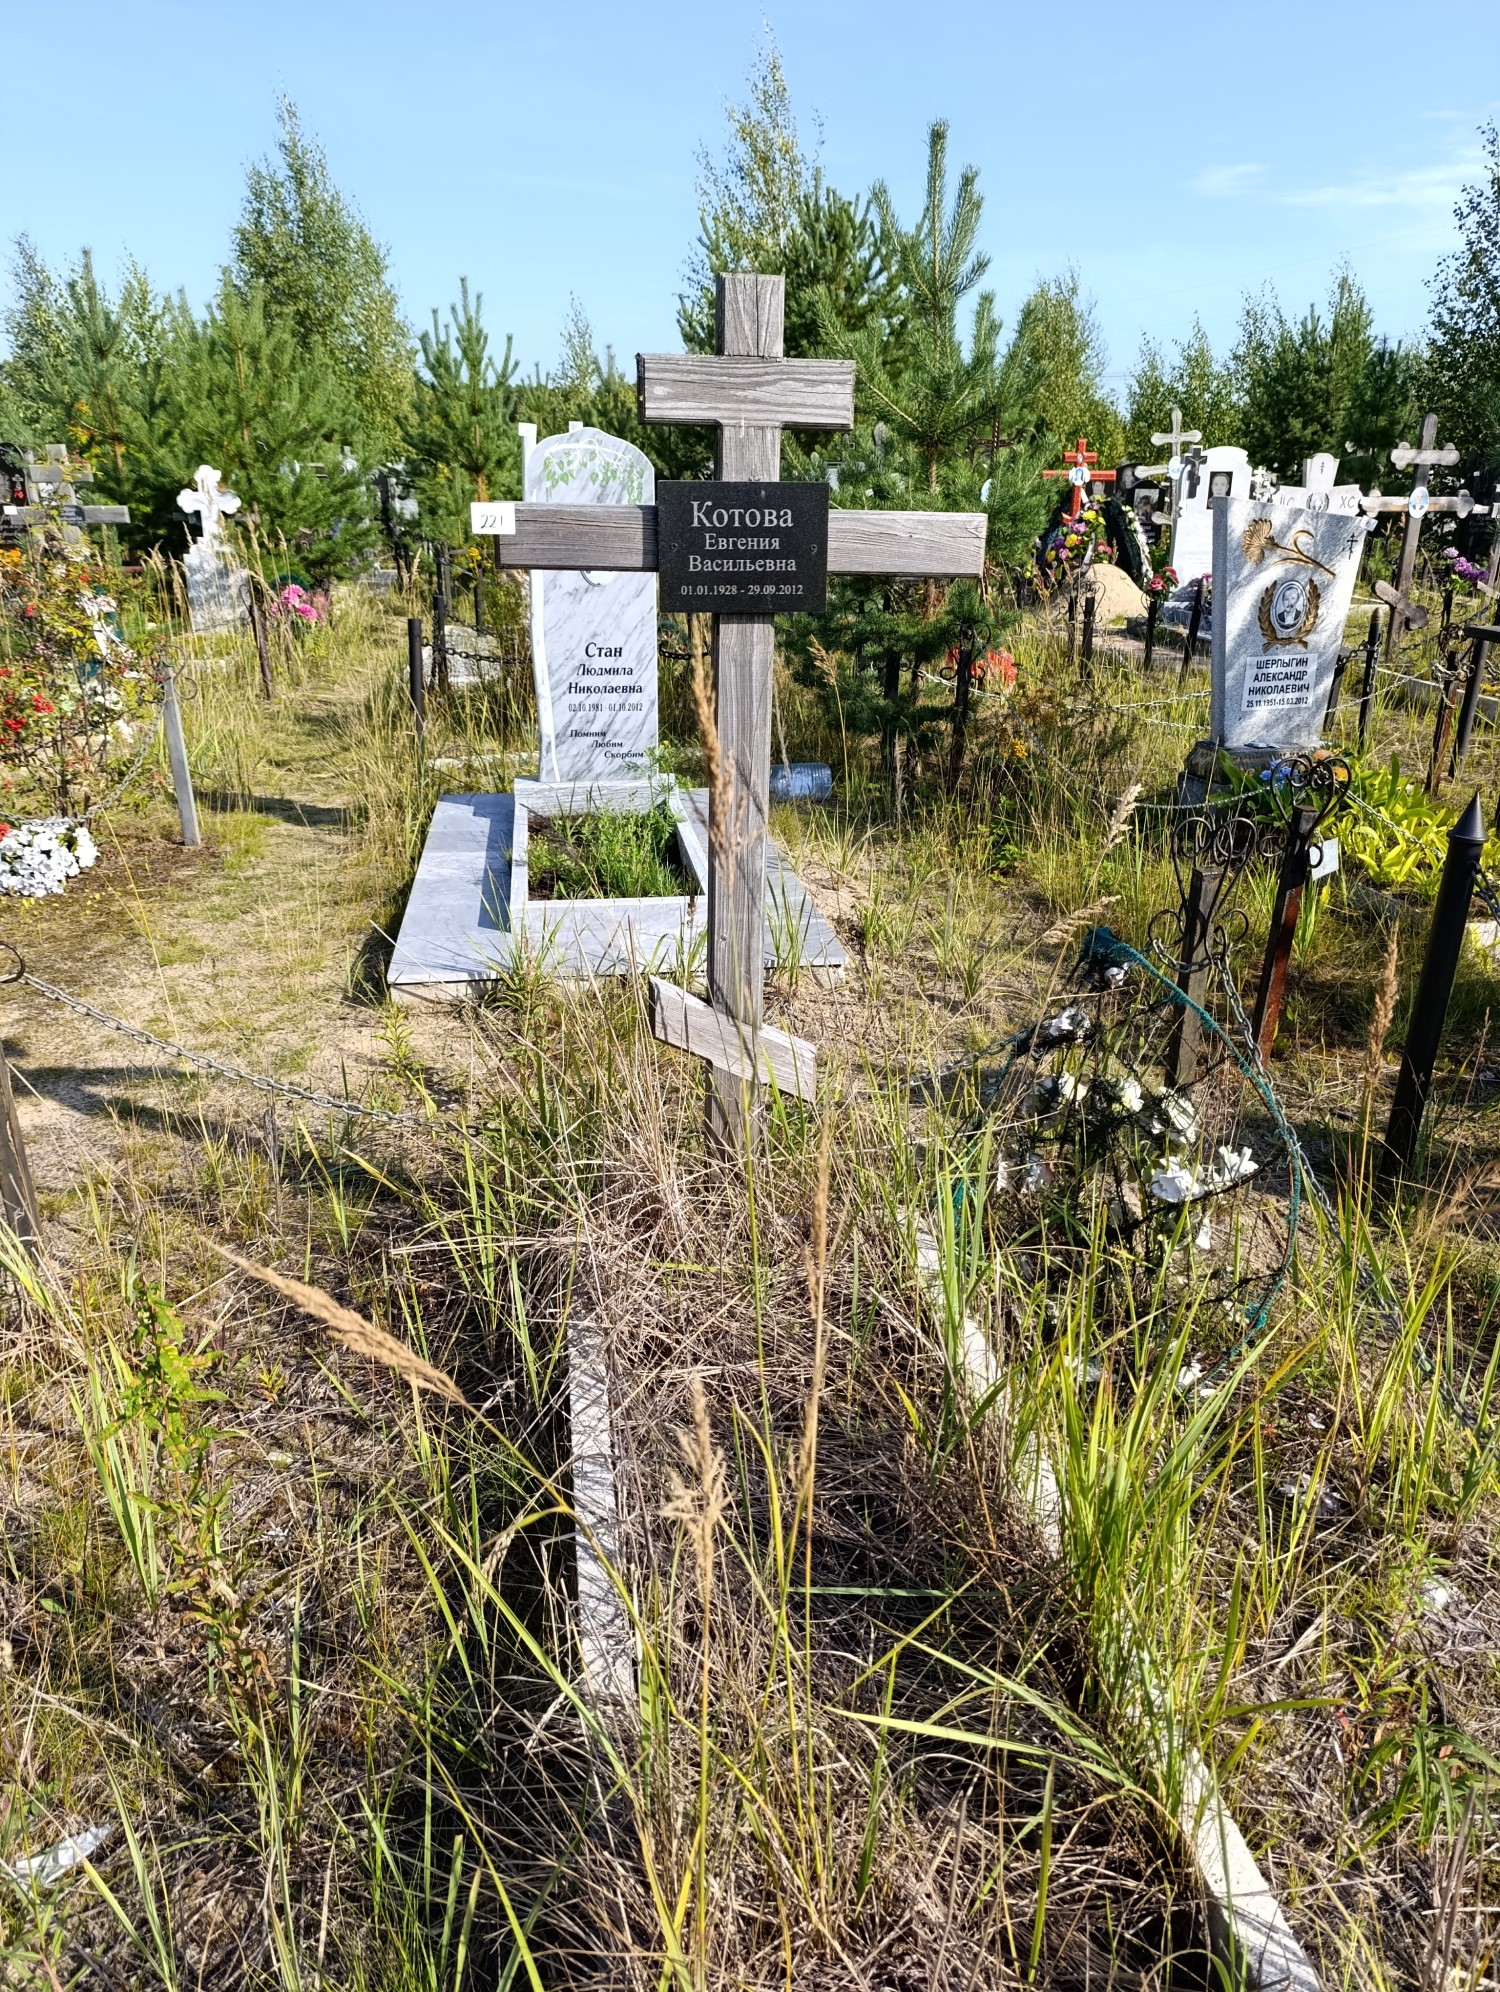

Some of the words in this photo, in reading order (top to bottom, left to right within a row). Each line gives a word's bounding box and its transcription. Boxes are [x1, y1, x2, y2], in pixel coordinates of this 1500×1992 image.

[690, 501, 794, 528] Котова
[480, 514, 503, 529] 221
[704, 533, 781, 551] Евгения
[688, 555, 797, 572] Васильевна
[680, 585, 738, 596] 01.01.1928
[747, 584, 804, 596] 29.09.2012
[584, 641, 623, 658] Стан
[576, 663, 634, 676] Людмила
[1256, 657, 1309, 670] ШЕРЛЫГИН
[1252, 670, 1308, 683] АЛЕКСАНДР
[568, 682, 643, 695] Николаевна
[1248, 683, 1310, 697] НИКОЛАЕВИЧ
[568, 703, 603, 712] 02.10.1981
[570, 729, 607, 738] Помним
[591, 740, 623, 748] Любим
[604, 750, 644, 759] Скорбим
